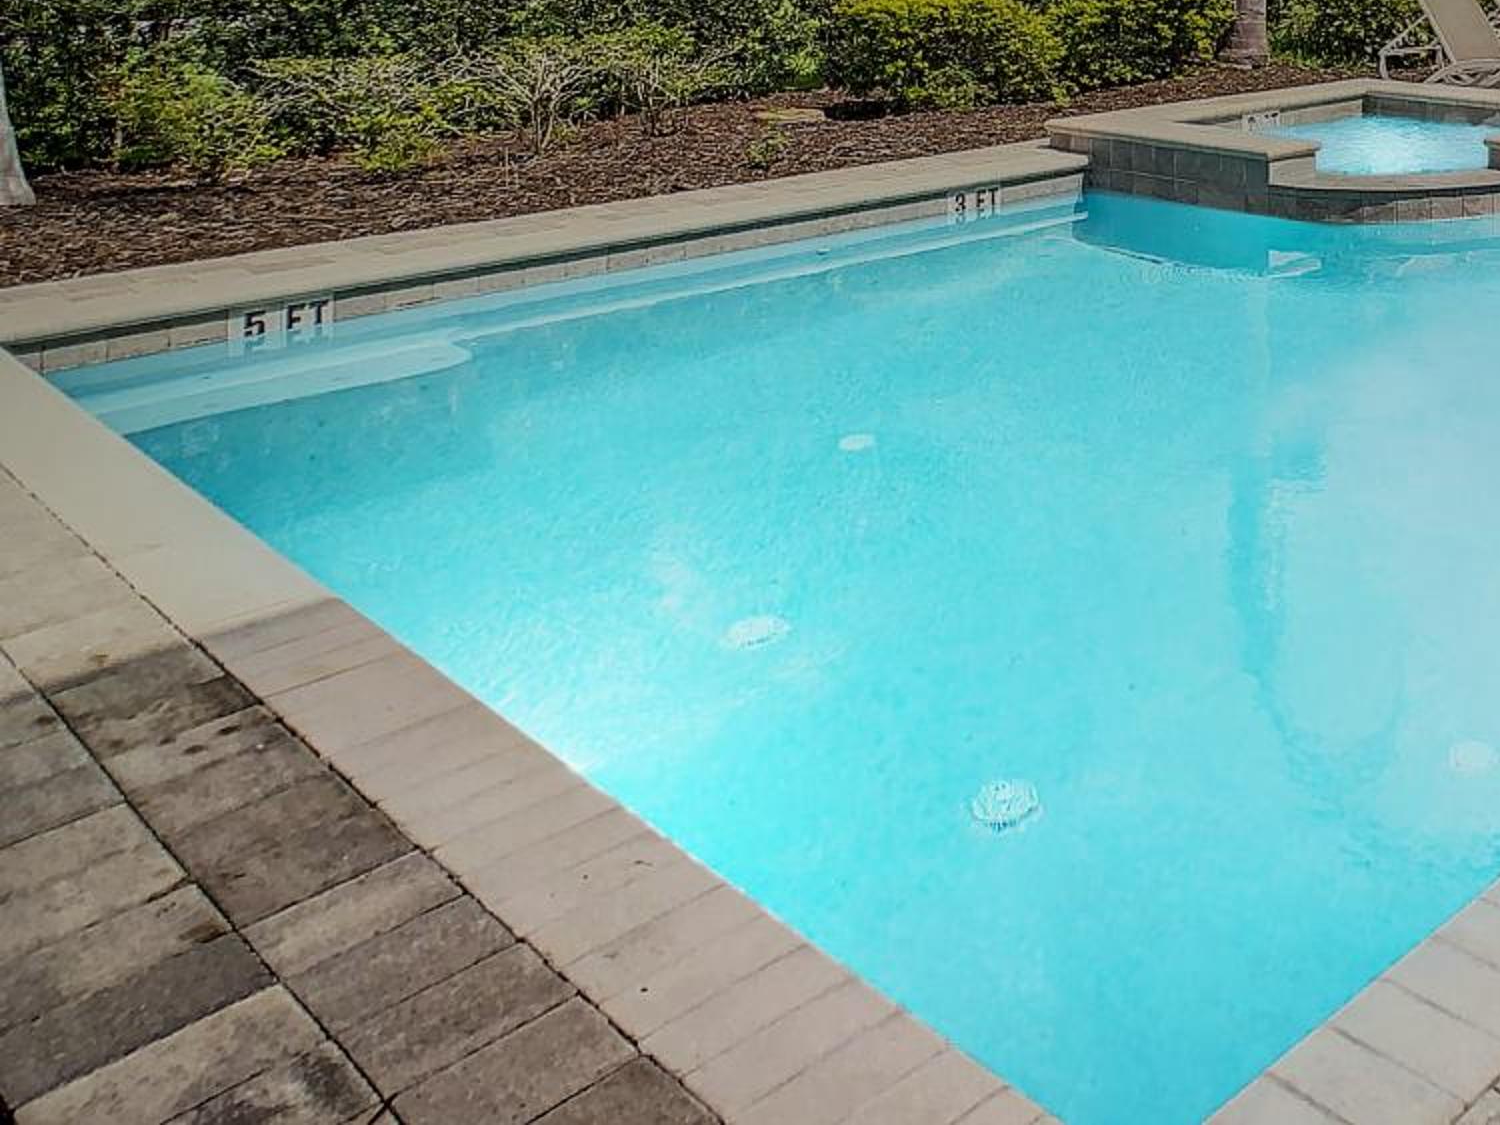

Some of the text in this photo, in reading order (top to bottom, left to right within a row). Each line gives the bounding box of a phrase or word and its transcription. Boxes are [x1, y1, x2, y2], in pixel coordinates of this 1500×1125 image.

[955, 186, 999, 212] 3 FT
[243, 298, 330, 337] 5 FT
